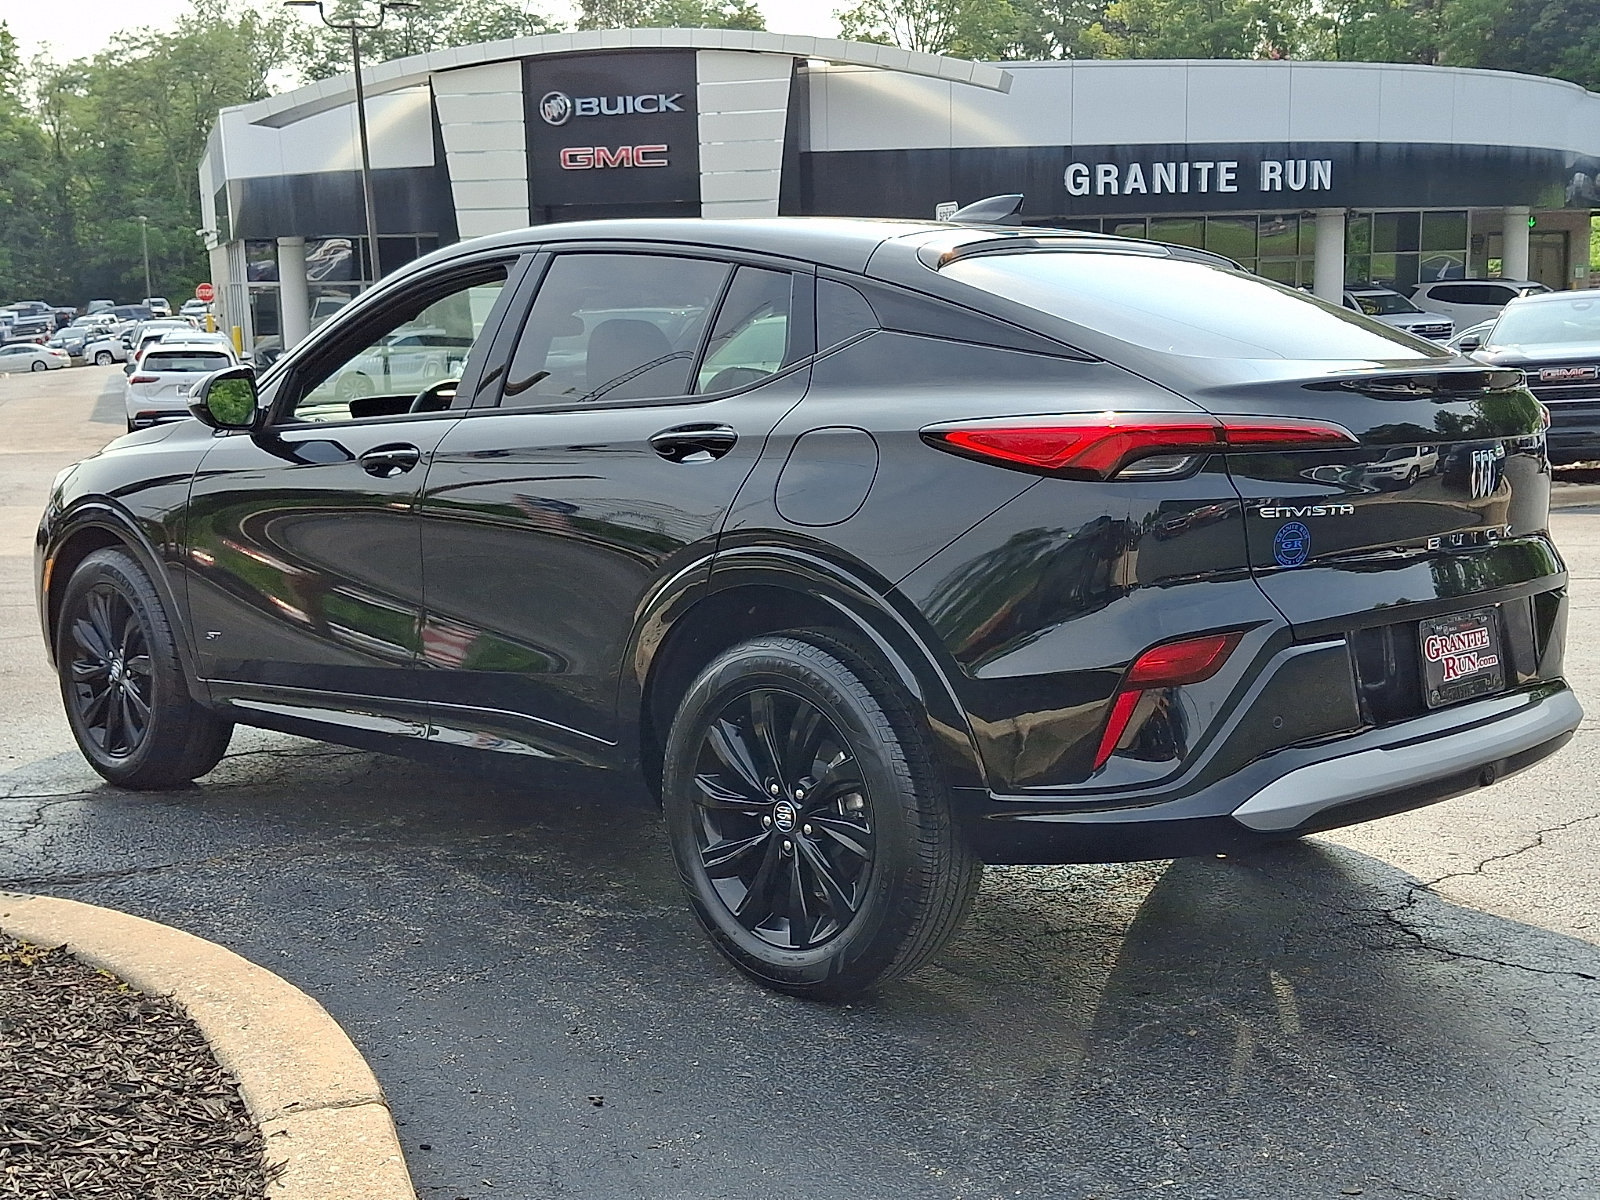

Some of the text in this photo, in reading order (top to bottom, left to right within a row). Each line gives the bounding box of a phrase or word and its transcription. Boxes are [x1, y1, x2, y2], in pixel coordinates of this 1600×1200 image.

[575, 93, 685, 116] BUICK
[560, 144, 668, 169] GMC
[1064, 159, 1333, 195] GRANITE RUN
[1542, 367, 1595, 379] GMC
[1259, 504, 1355, 518] ENVISTA
[1282, 541, 1302, 549] GR
[1427, 525, 1512, 550] BUICK
[1425, 628, 1490, 661] GRANITE
[1442, 653, 1498, 681] RUN.com
